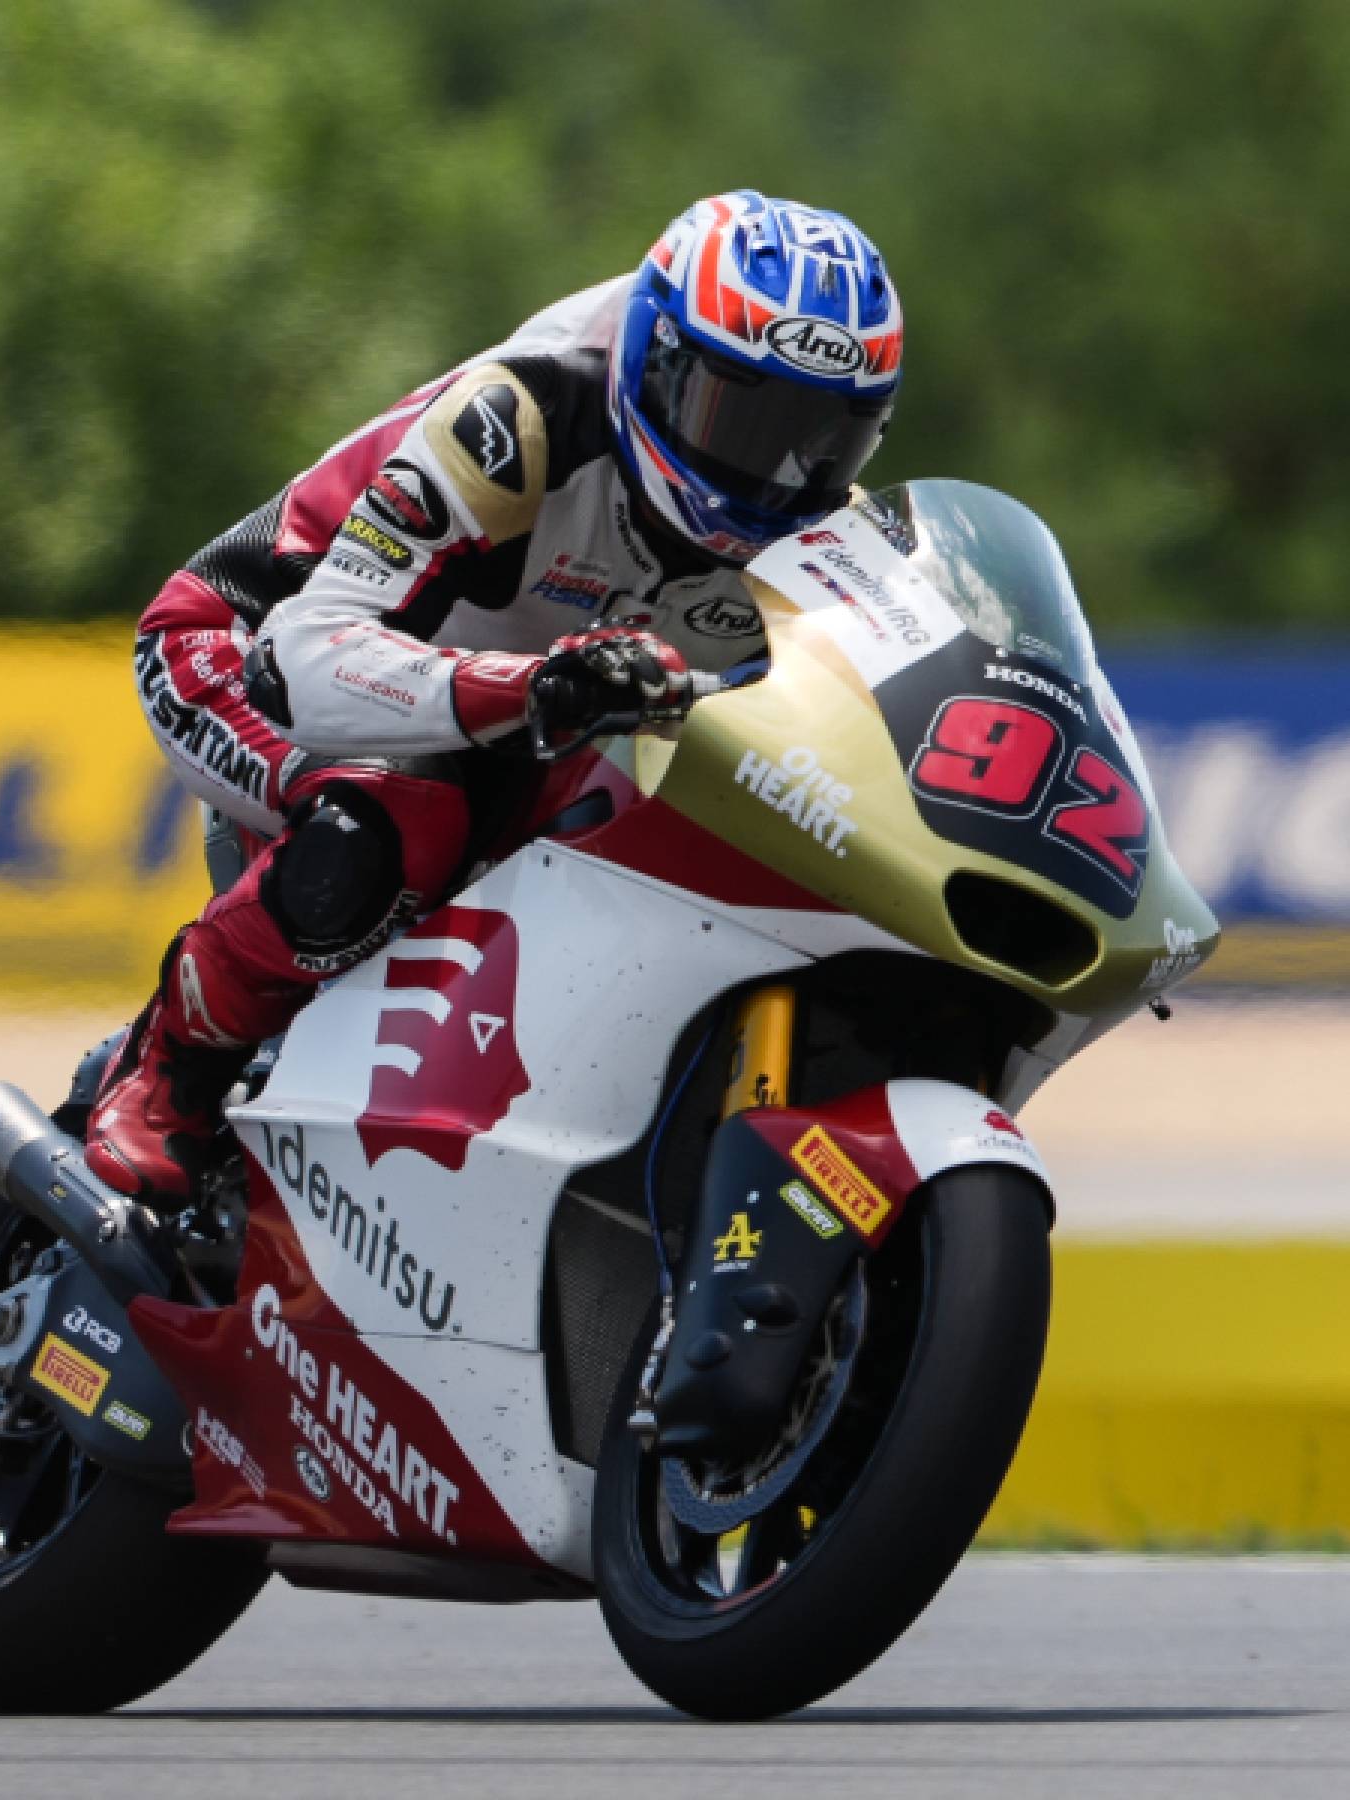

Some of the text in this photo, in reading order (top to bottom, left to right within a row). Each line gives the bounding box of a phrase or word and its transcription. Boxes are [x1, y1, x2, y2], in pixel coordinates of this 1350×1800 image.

[767, 321, 852, 367] Arai
[688, 596, 762, 636] Arai
[983, 662, 1090, 727] HONDA
[734, 749, 859, 859] HEART.
[782, 747, 854, 806] One
[909, 695, 1148, 898] 92
[251, 1282, 460, 1546] One HEART.
[290, 1392, 401, 1538] HONDA
